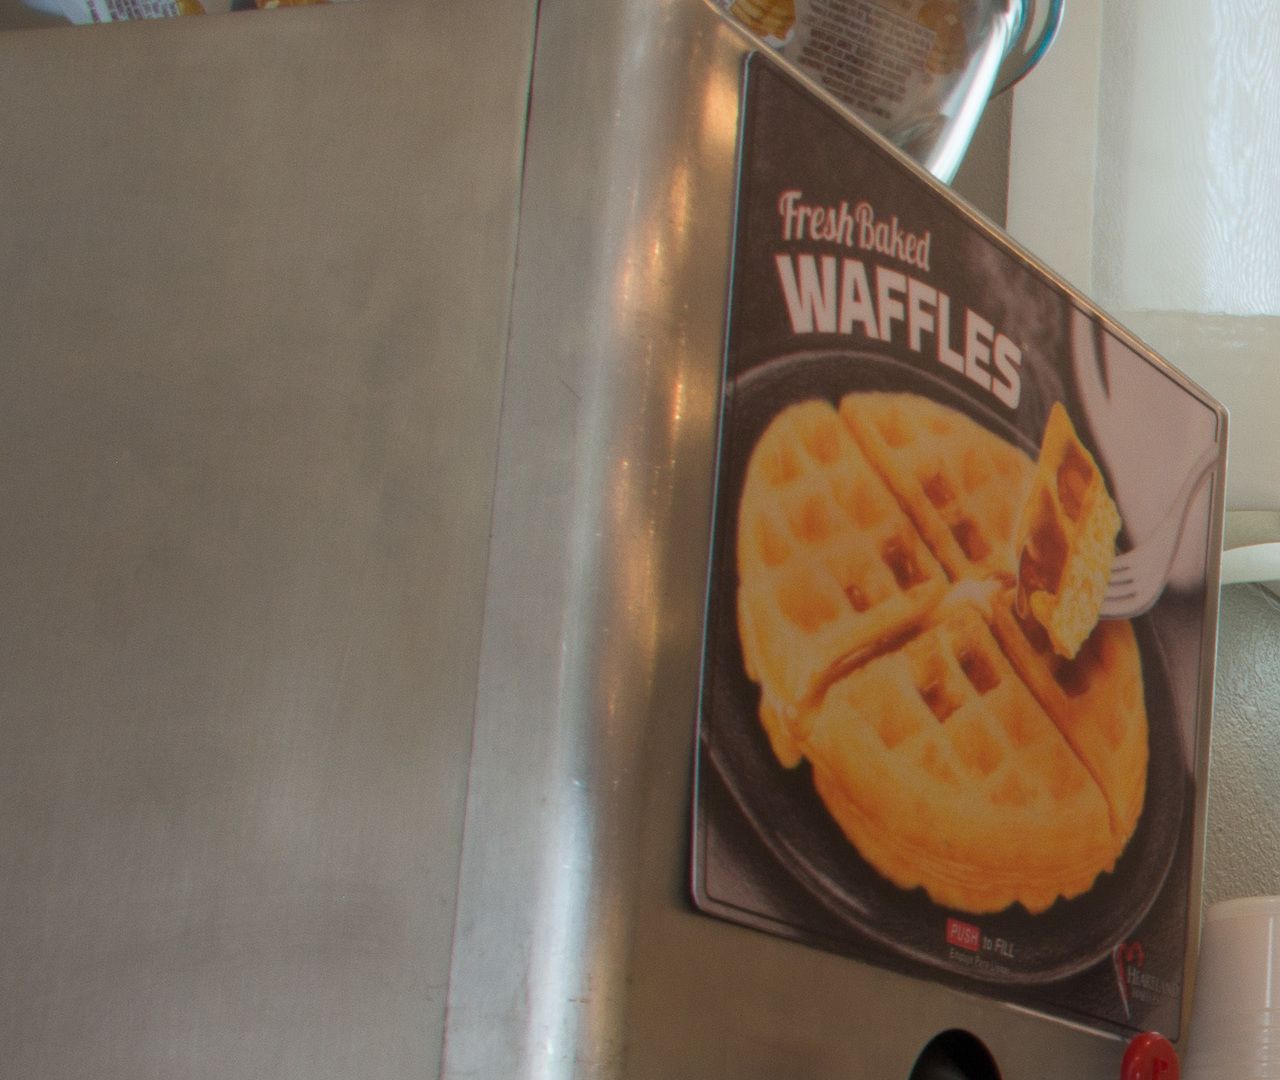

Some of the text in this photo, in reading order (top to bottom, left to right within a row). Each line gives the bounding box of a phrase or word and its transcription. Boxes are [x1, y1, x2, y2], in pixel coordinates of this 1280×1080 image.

[778, 189, 932, 272] Fresh Baked
[775, 254, 1023, 410] WAFFLES
[950, 923, 979, 945] PUSH
